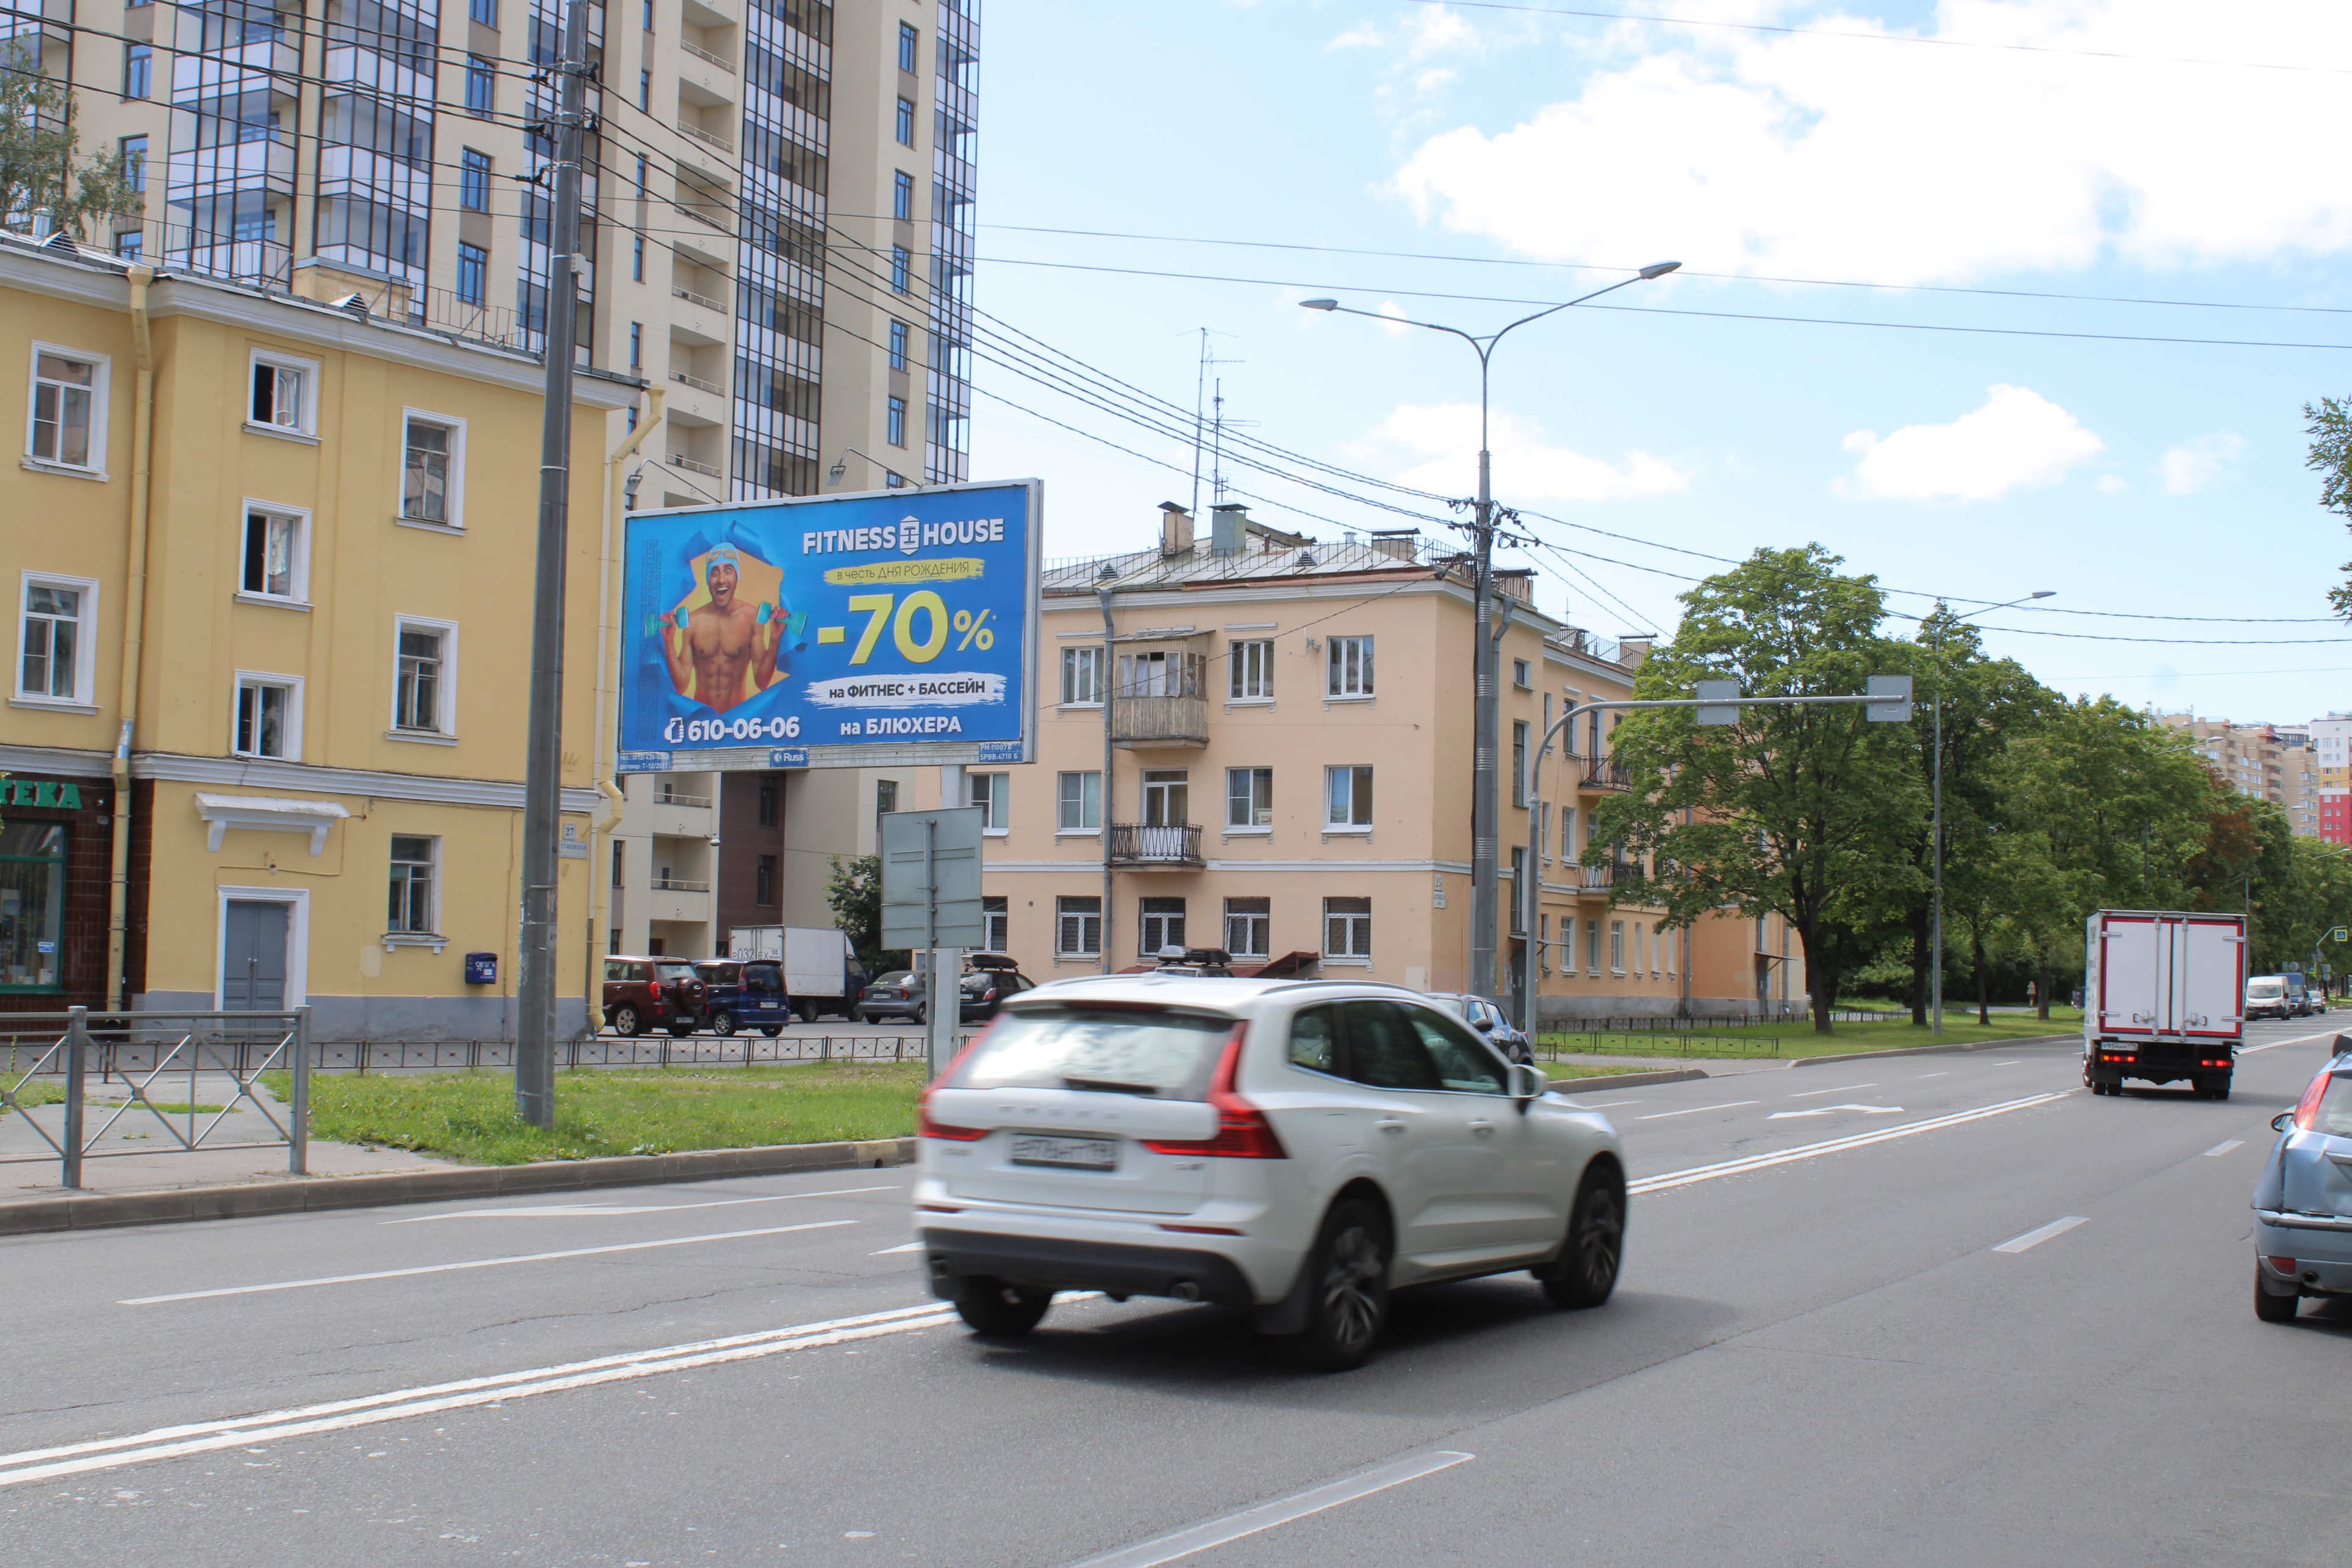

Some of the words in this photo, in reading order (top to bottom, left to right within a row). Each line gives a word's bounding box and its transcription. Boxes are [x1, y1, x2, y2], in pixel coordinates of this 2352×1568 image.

[804, 526, 896, 555] FITNESS
[924, 518, 1004, 546] HOUSE
[845, 569, 874, 579] честь
[878, 567, 902, 580] ДНЯ
[904, 562, 970, 577] РОЖДЕНИЯ
[829, 688, 844, 699] на
[847, 683, 905, 698] ФИТНЕС
[919, 677, 986, 696] БАССЕЙН
[688, 716, 800, 742] 610-06-06
[840, 722, 861, 736] на
[866, 716, 962, 734] БЛЮХЕРА
[783, 752, 804, 762] Russ
[565, 827, 575, 837] 27
[1435, 876, 1442, 888] 25
